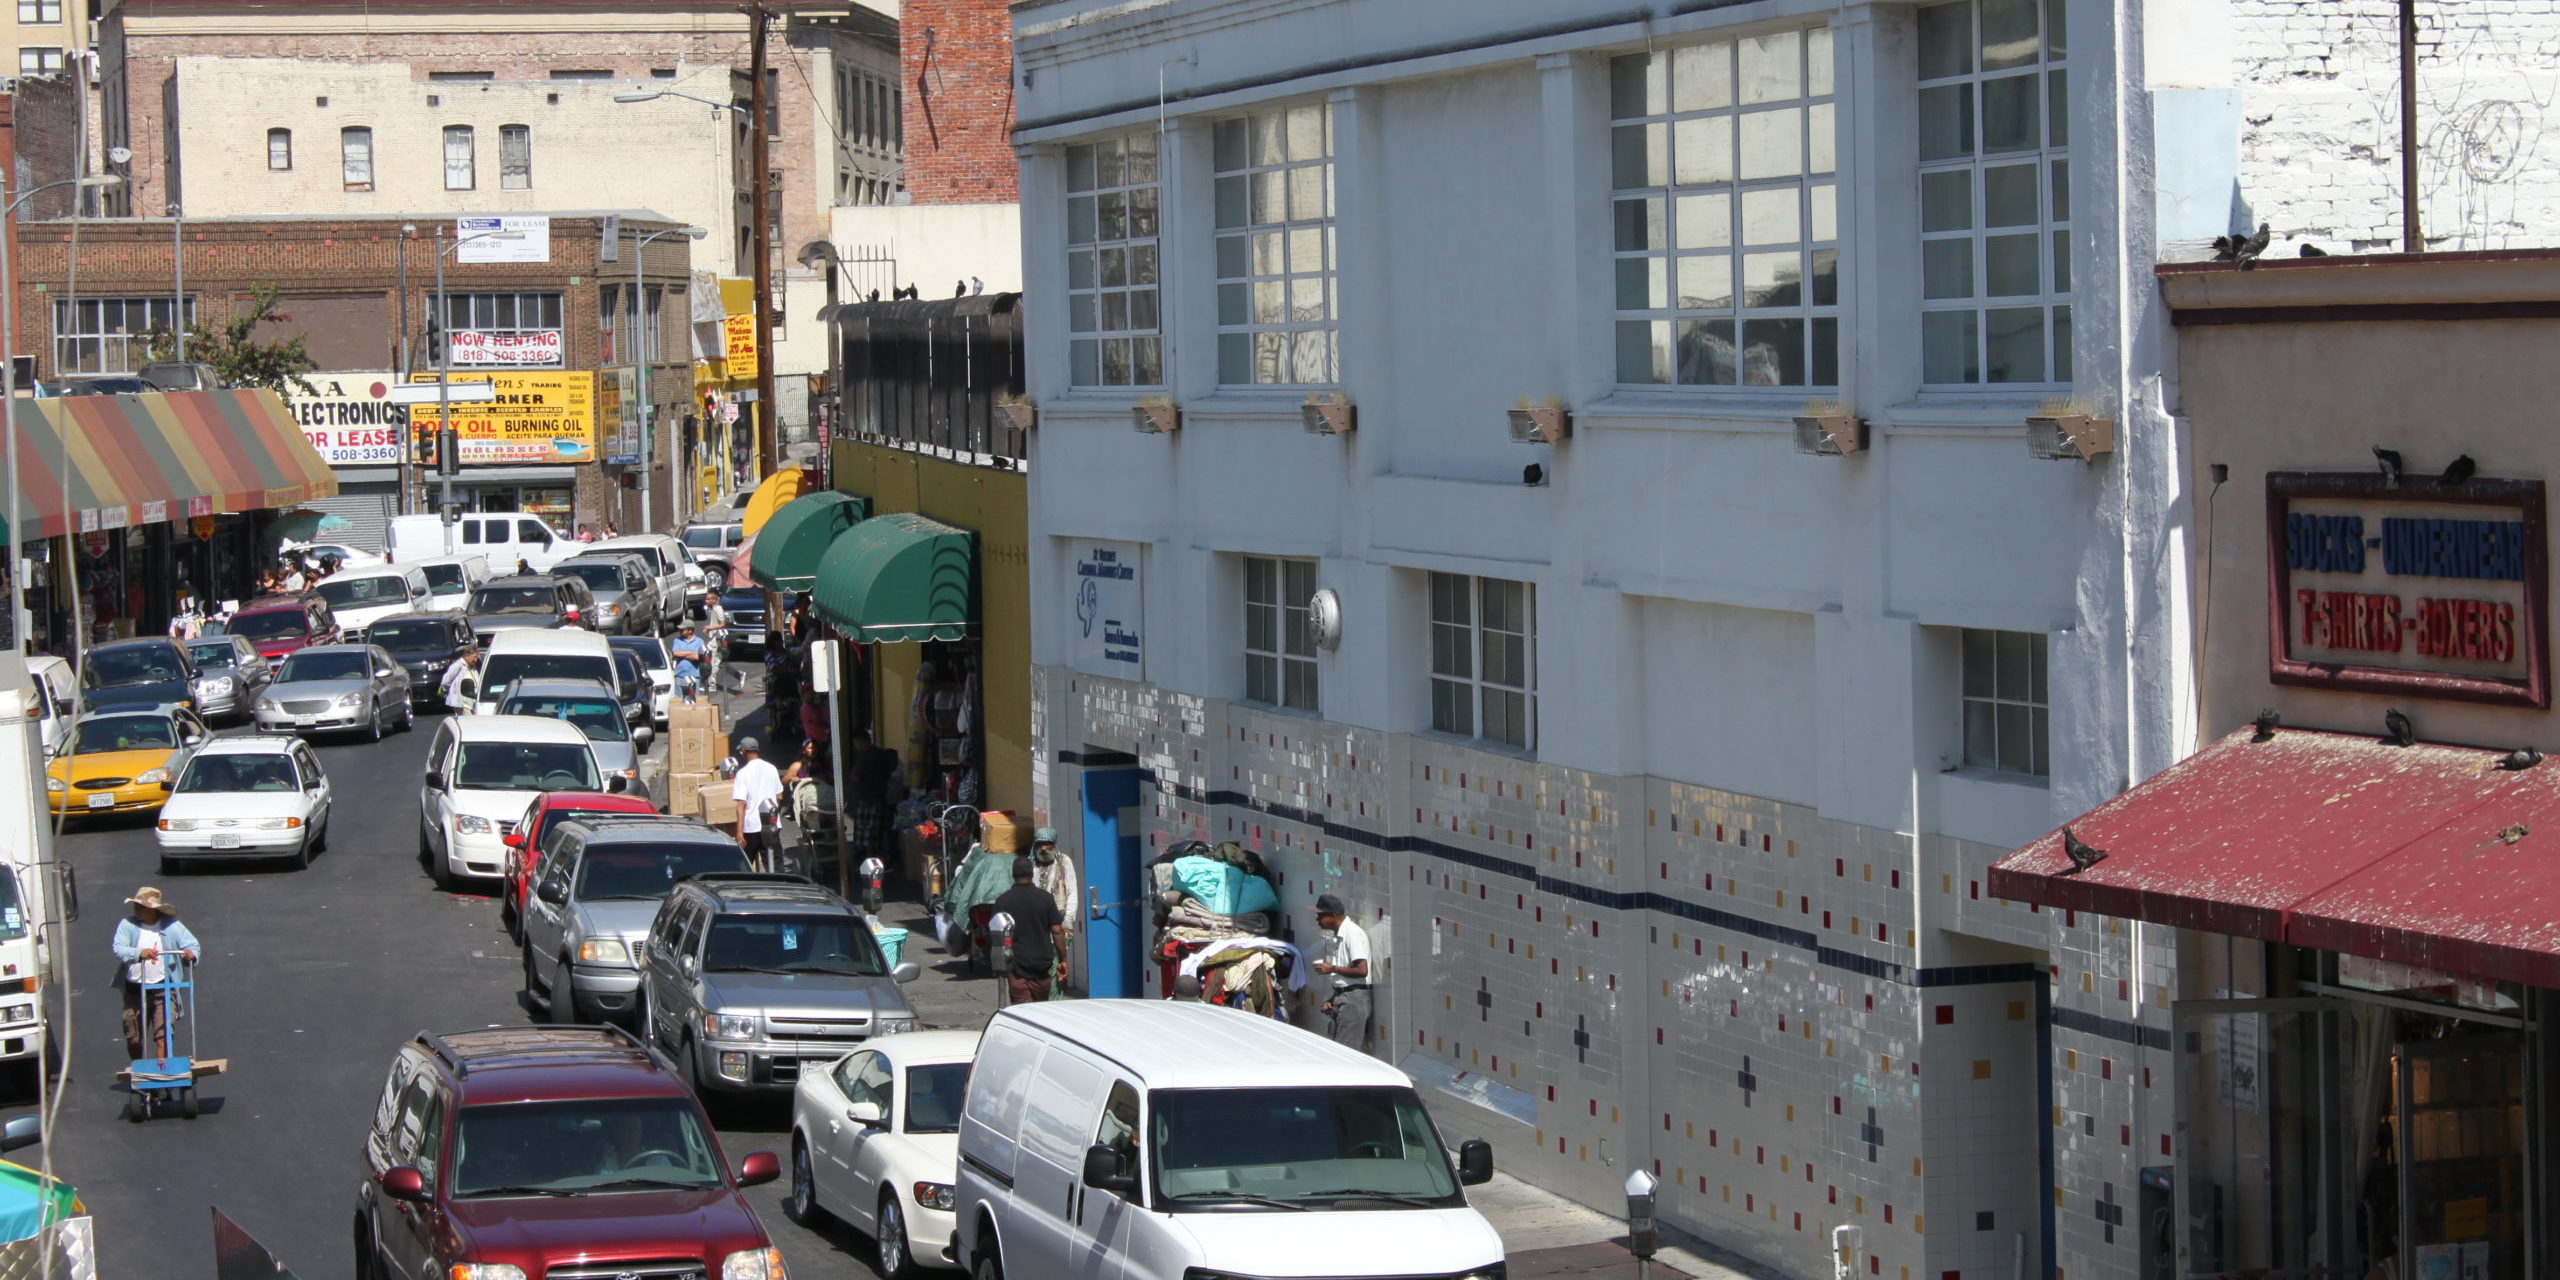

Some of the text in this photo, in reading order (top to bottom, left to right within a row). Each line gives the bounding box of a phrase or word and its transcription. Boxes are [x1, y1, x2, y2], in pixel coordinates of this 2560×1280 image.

[523, 219, 546, 227] LEASE
[453, 333, 557, 346] NOW RENTING
[459, 350, 552, 361] (818) 508-3360
[468, 420, 496, 432] OIL
[505, 419, 582, 432] BURNING OIL
[338, 430, 398, 447] LEASE
[332, 448, 397, 460] 508-3360
[2287, 513, 2365, 574] SOCKS
[2381, 517, 2524, 581] UNDERWEAR
[2297, 588, 2402, 653] T-SHIRTS
[2416, 596, 2514, 662] BOXERS
